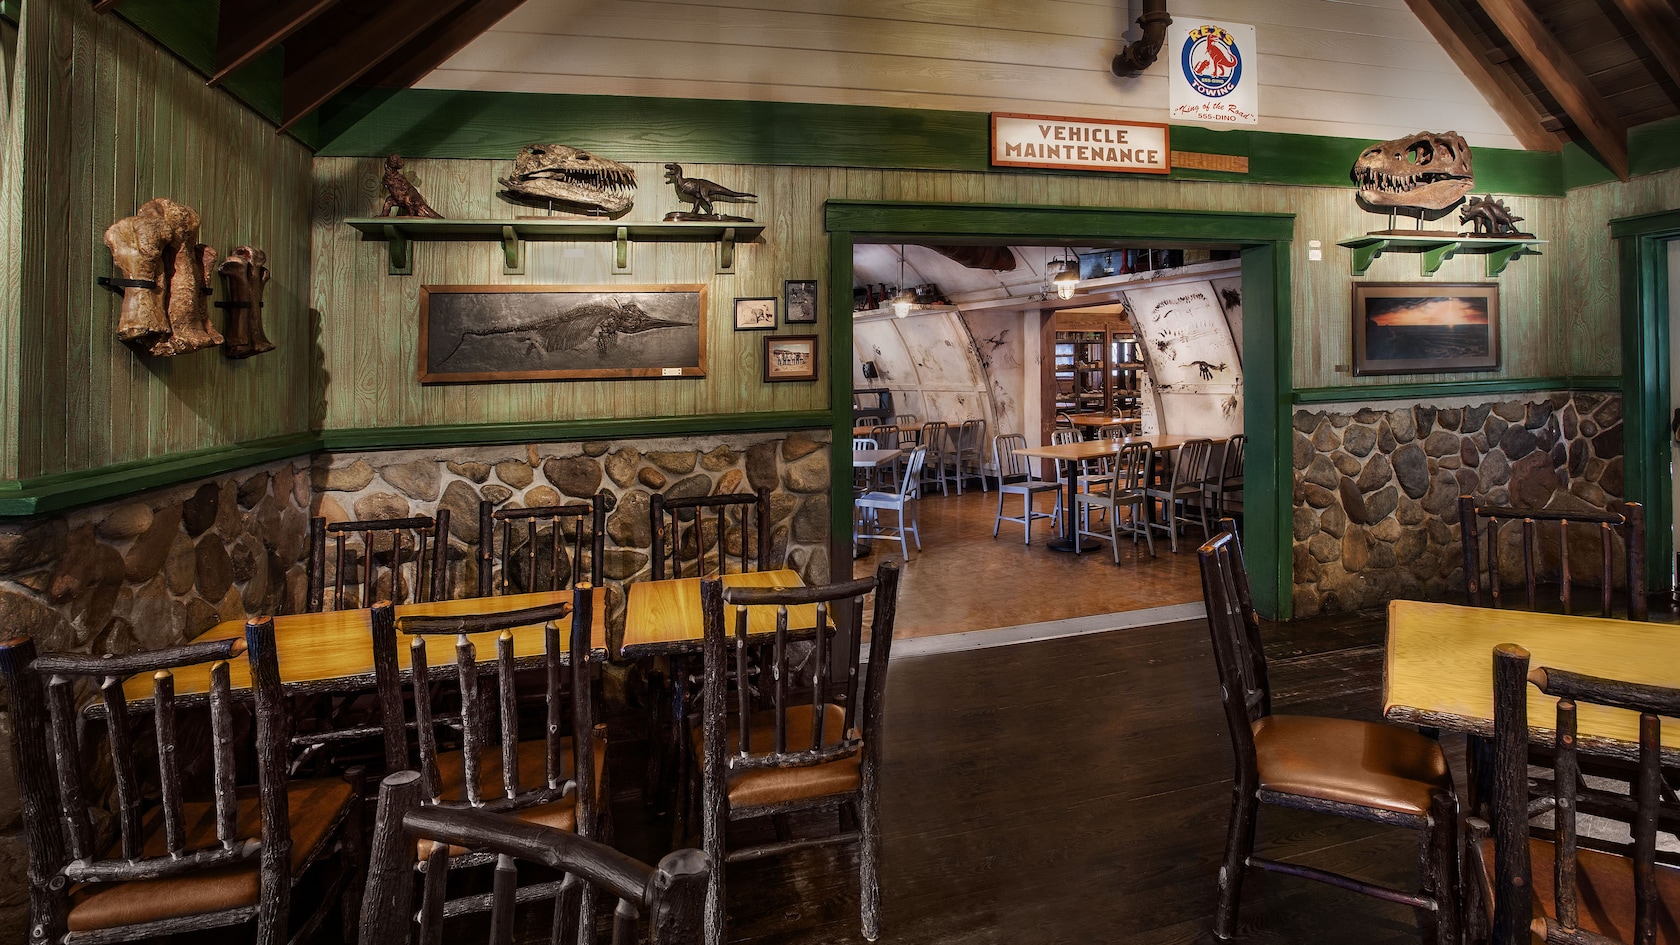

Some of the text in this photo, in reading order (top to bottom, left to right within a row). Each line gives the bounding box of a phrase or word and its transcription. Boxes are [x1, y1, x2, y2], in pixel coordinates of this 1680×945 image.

[1188, 25, 1235, 46] REX'S
[1192, 80, 1235, 96] TOWING
[1202, 101, 1211, 112] of
[1213, 101, 1225, 111] the
[1198, 113, 1237, 121] 555-DINO
[1038, 124, 1129, 145] VEHICLE
[1005, 141, 1159, 164] MAINTENANCE
